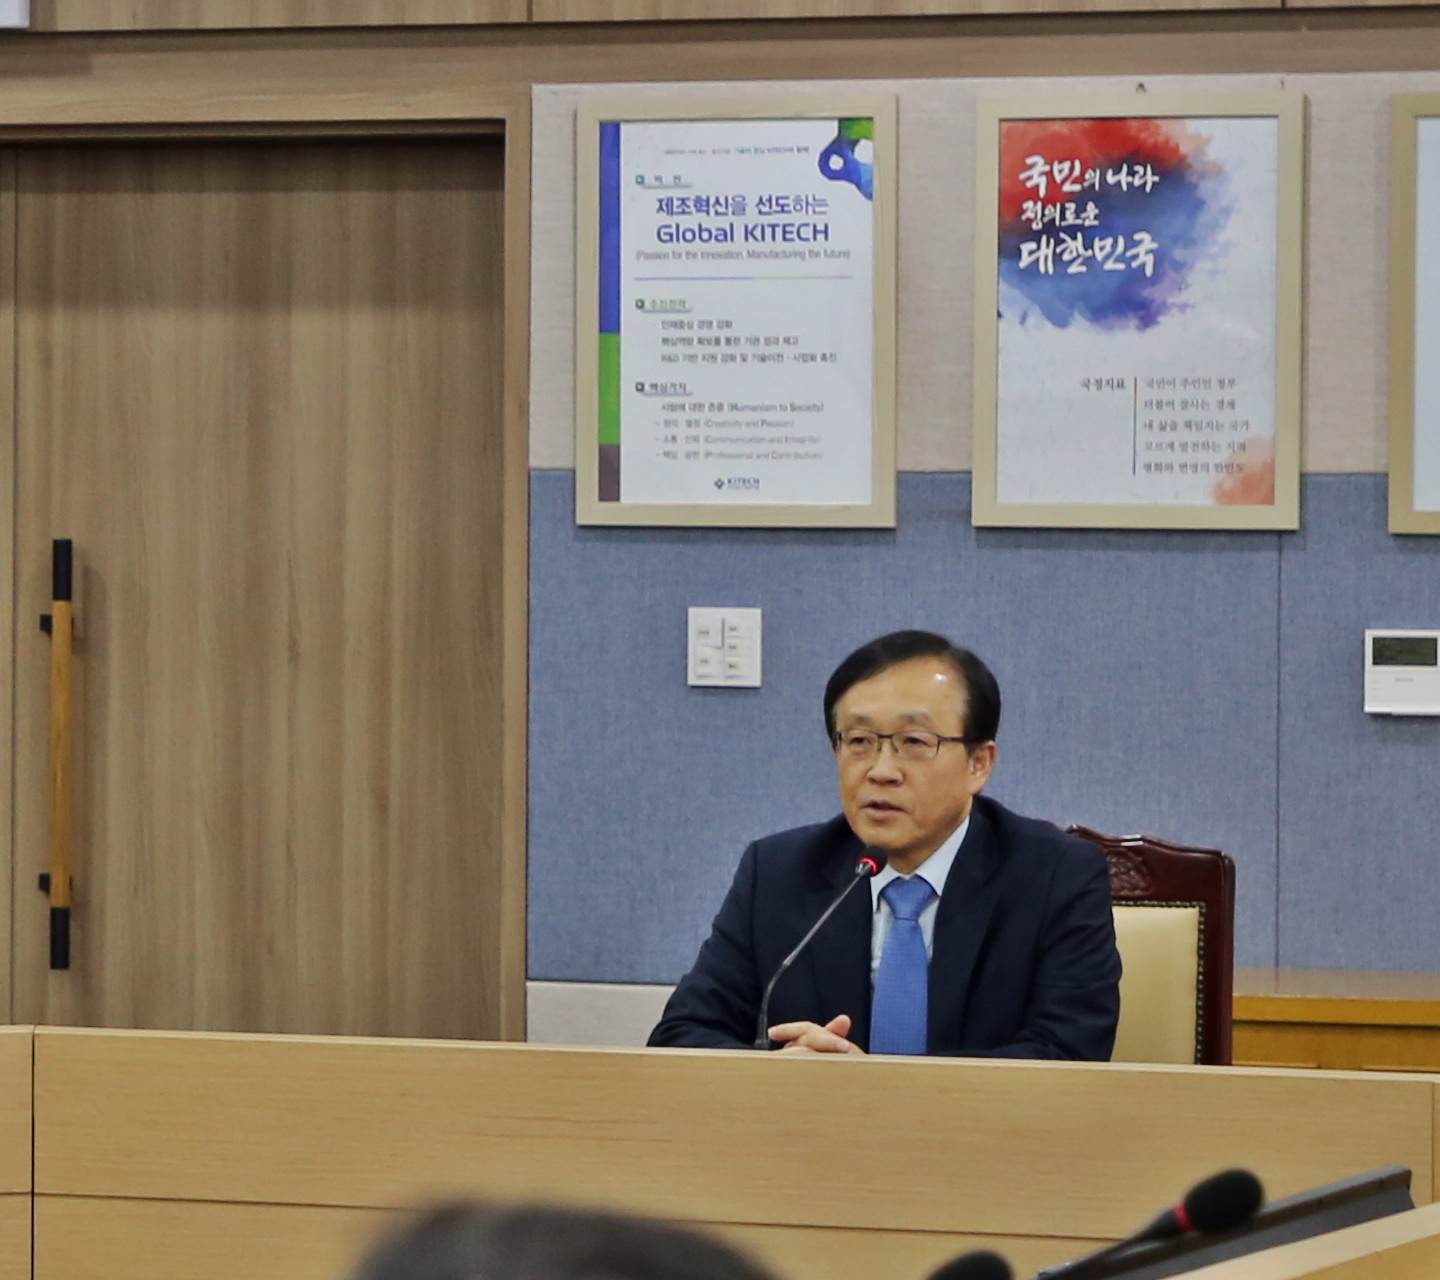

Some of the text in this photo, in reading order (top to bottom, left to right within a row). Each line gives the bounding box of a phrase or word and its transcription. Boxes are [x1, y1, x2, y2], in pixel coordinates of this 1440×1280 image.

[1019, 154, 1161, 198] 국민의 나라
[656, 194, 829, 216] 제조혁신을 선도하는
[1021, 200, 1101, 231] 정의로운
[656, 222, 830, 244] Global KITECH
[747, 249, 807, 262] Manufacturing
[808, 248, 822, 260] the
[1019, 231, 1160, 278] 대한민국
